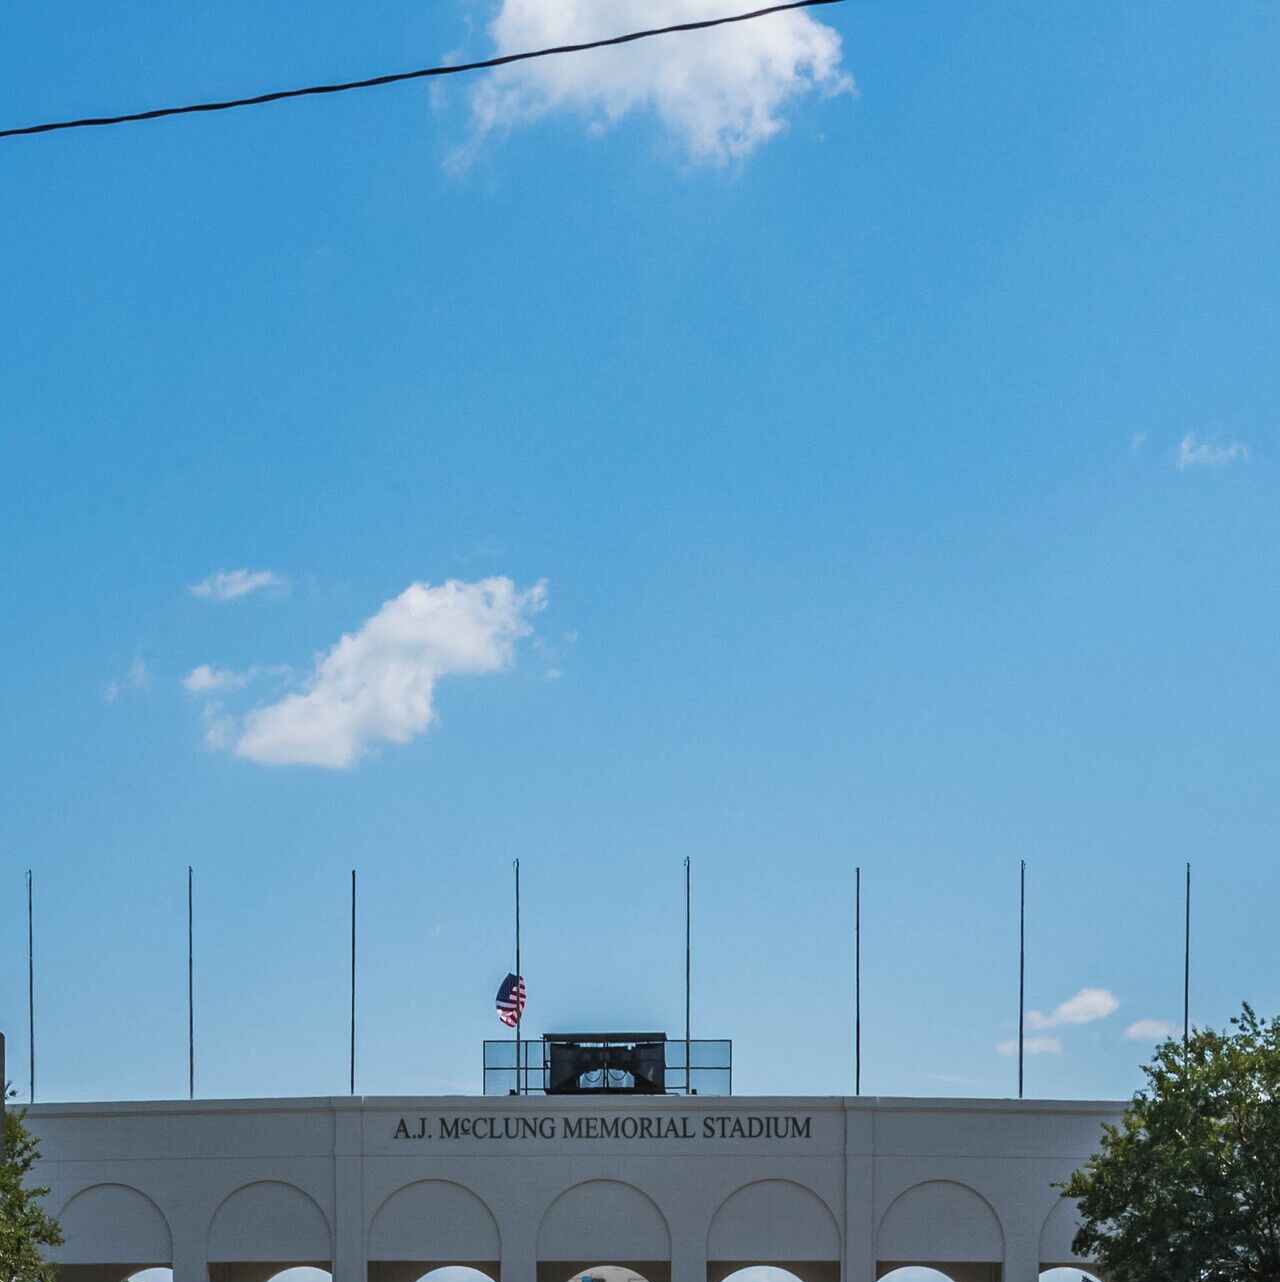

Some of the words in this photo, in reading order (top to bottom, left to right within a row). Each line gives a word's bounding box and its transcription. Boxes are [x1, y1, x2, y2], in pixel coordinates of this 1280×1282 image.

[394, 1117, 432, 1139] A.J.
[562, 1117, 696, 1139] MEMORIAL
[703, 1116, 813, 1139] STADIUM
